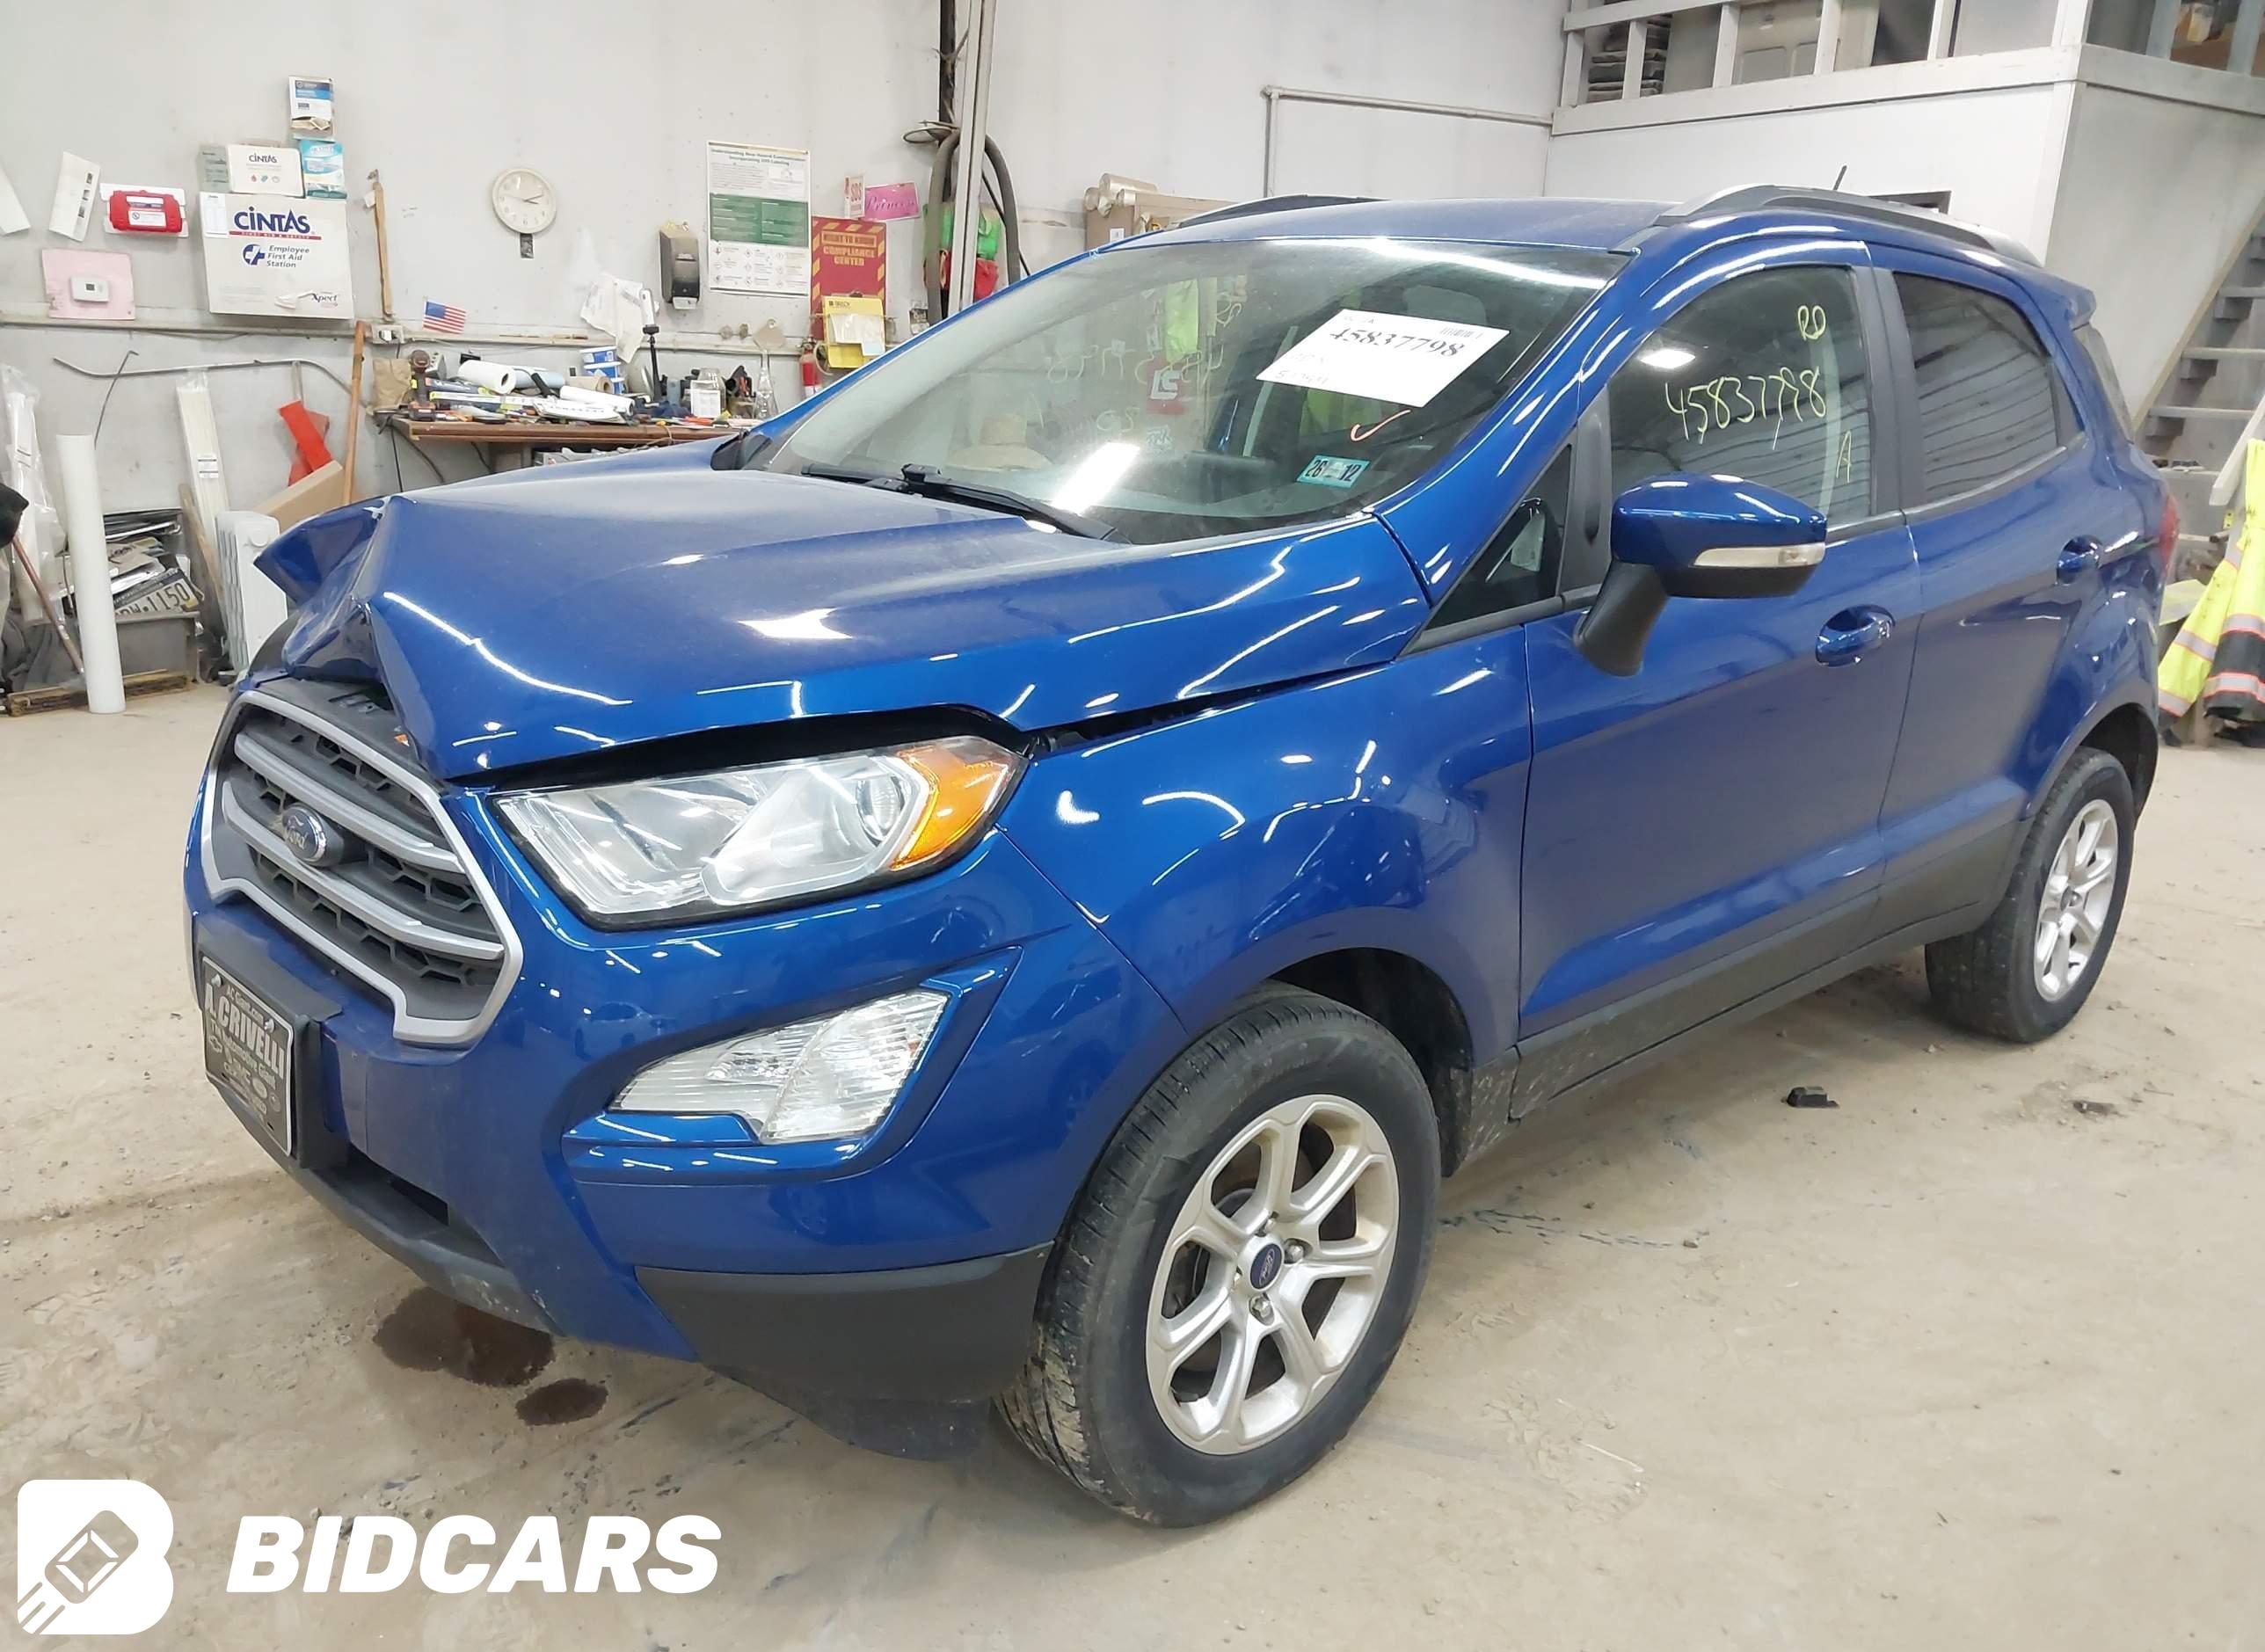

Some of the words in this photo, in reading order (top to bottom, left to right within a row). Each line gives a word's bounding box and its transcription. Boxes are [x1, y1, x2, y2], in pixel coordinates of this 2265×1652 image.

[269, 244, 310, 255] Employee
[1330, 327, 1465, 358] 45837798
[1664, 366, 1827, 448] 45837798
[1305, 459, 1329, 477] 26
[1338, 463, 1362, 482] 12
[219, 995, 285, 1080] CRIVELLI
